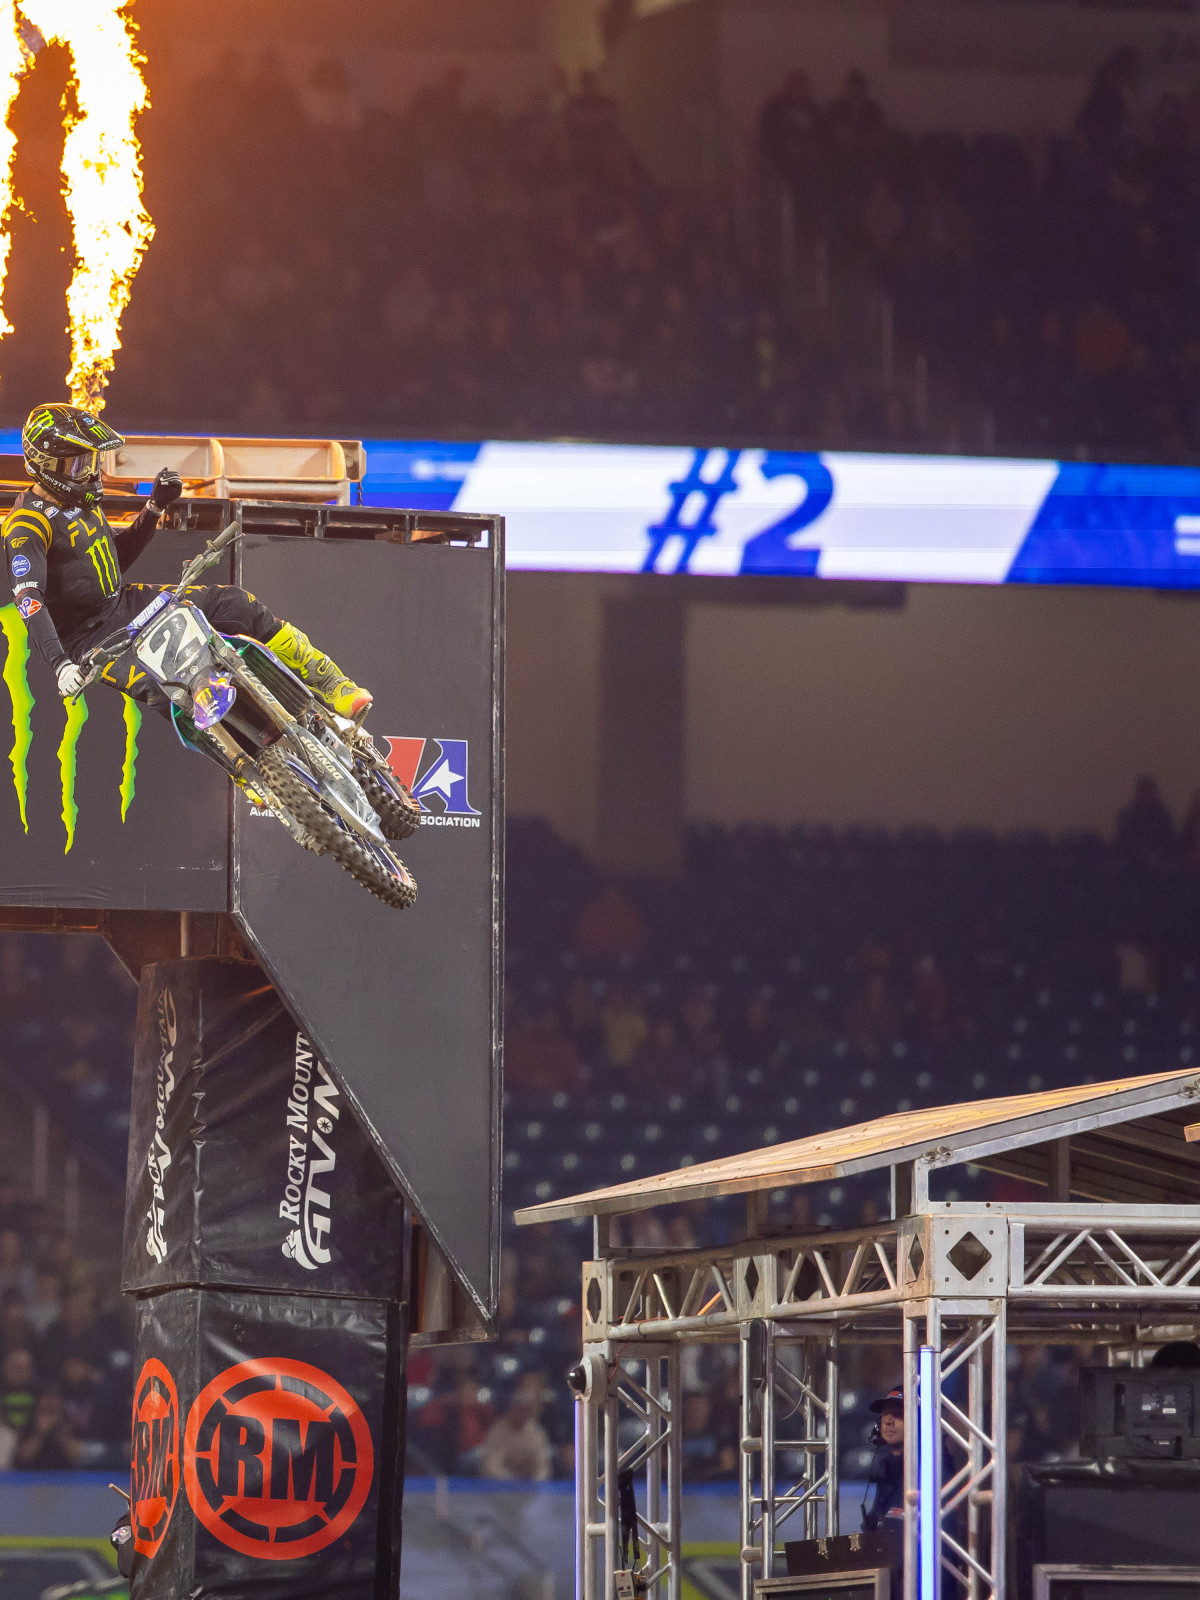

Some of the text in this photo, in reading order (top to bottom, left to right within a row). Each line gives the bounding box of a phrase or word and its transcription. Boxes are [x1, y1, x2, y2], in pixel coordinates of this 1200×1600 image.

[67, 505, 104, 548] FLY
[640, 446, 836, 577] #2
[17, 596, 33, 618] VP
[101, 659, 147, 690] LY
[300, 735, 345, 781] DUNLOP
[420, 815, 481, 828] SOCIATION
[279, 1031, 315, 1223] ROCKY MOUNT
[218, 1412, 337, 1503] RM
